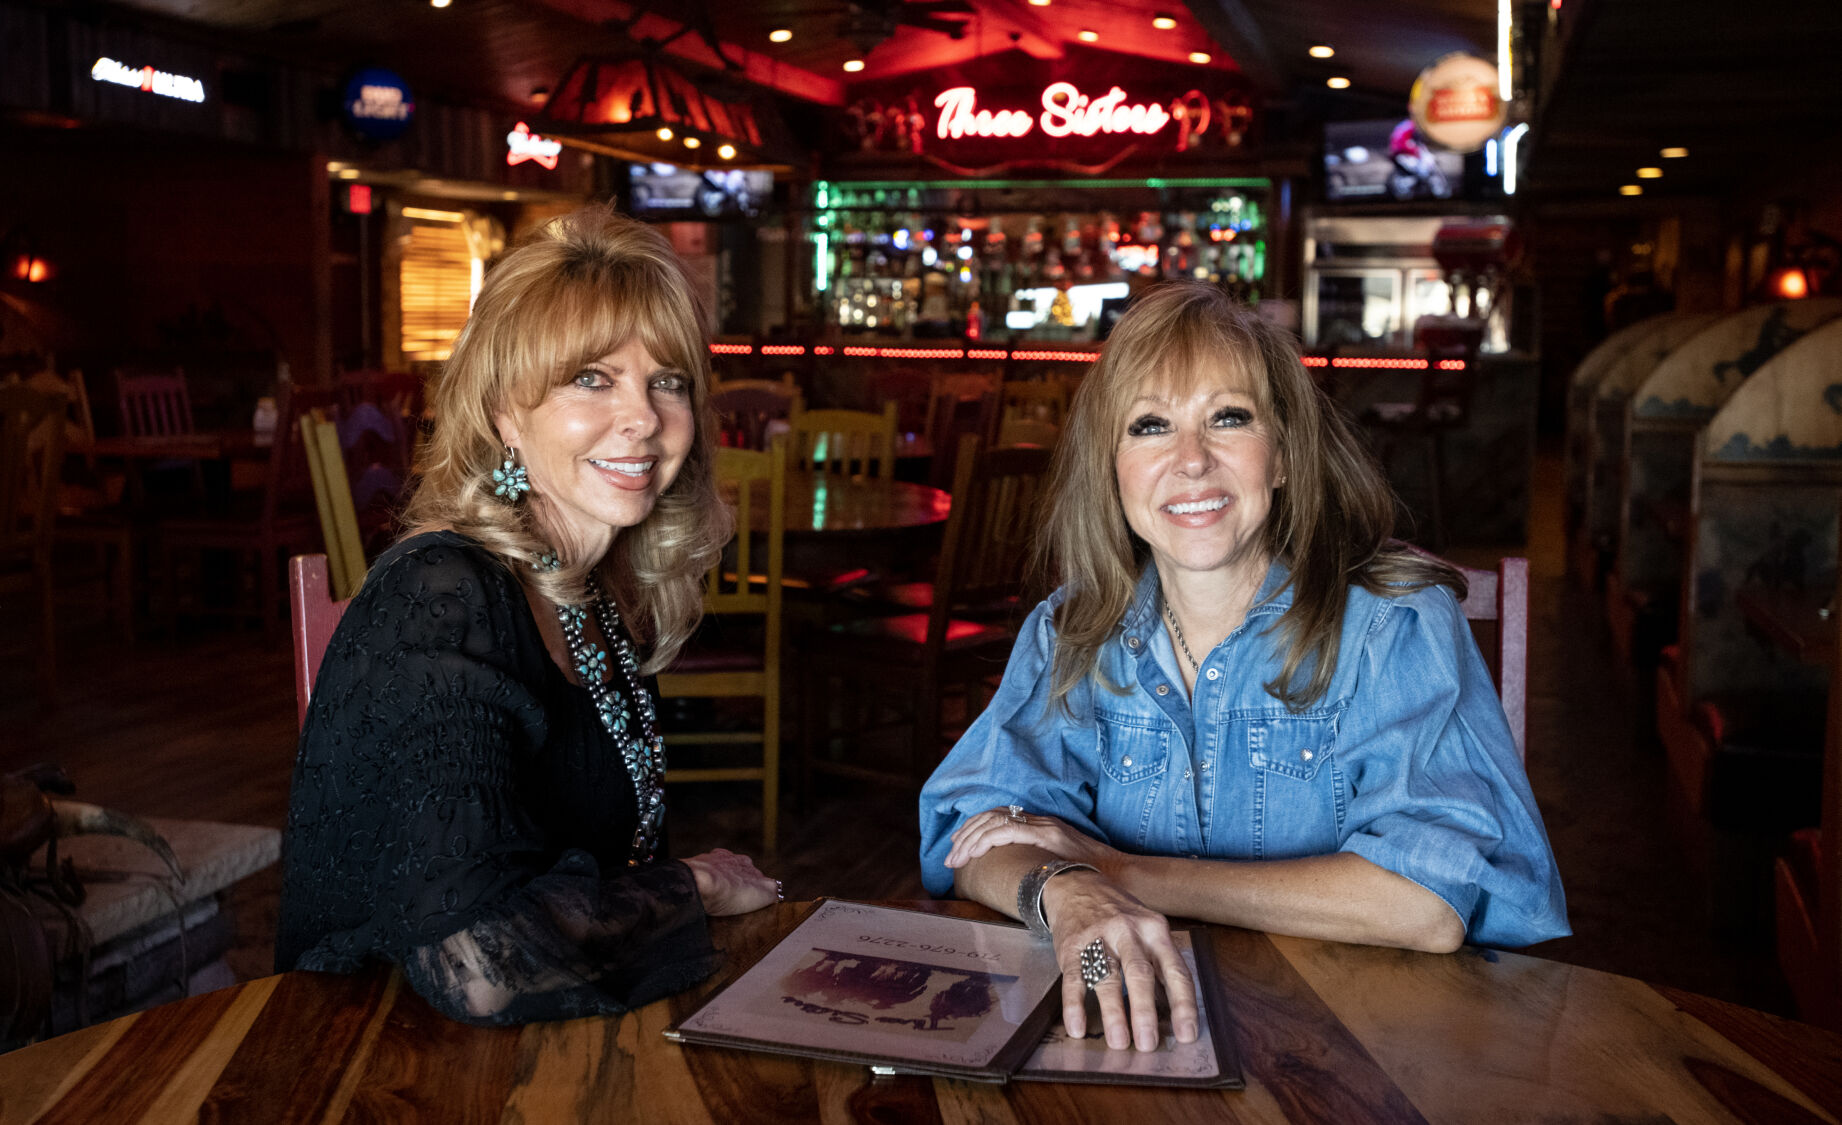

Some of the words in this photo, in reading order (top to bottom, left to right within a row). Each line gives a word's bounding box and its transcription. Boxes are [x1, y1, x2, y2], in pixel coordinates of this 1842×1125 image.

[934, 86, 1034, 140] Three
[1039, 81, 1171, 138] Sisters
[858, 934, 1001, 961] 719-676-2276
